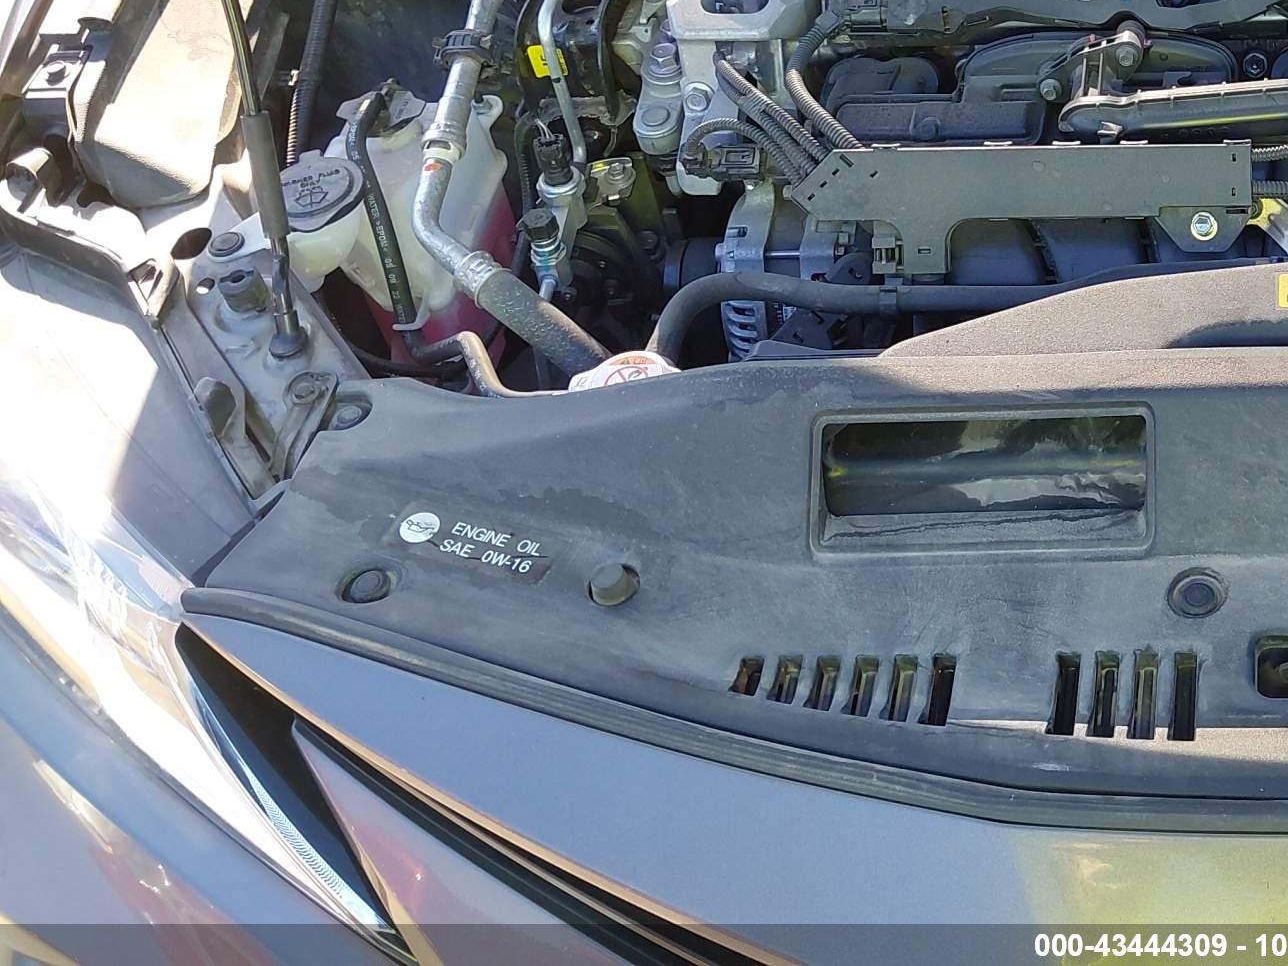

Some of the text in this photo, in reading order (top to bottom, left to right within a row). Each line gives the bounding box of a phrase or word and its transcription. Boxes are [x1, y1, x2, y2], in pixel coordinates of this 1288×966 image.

[439, 538, 533, 574] SAE 0W-16
[451, 521, 543, 556] ENGINE OIL
